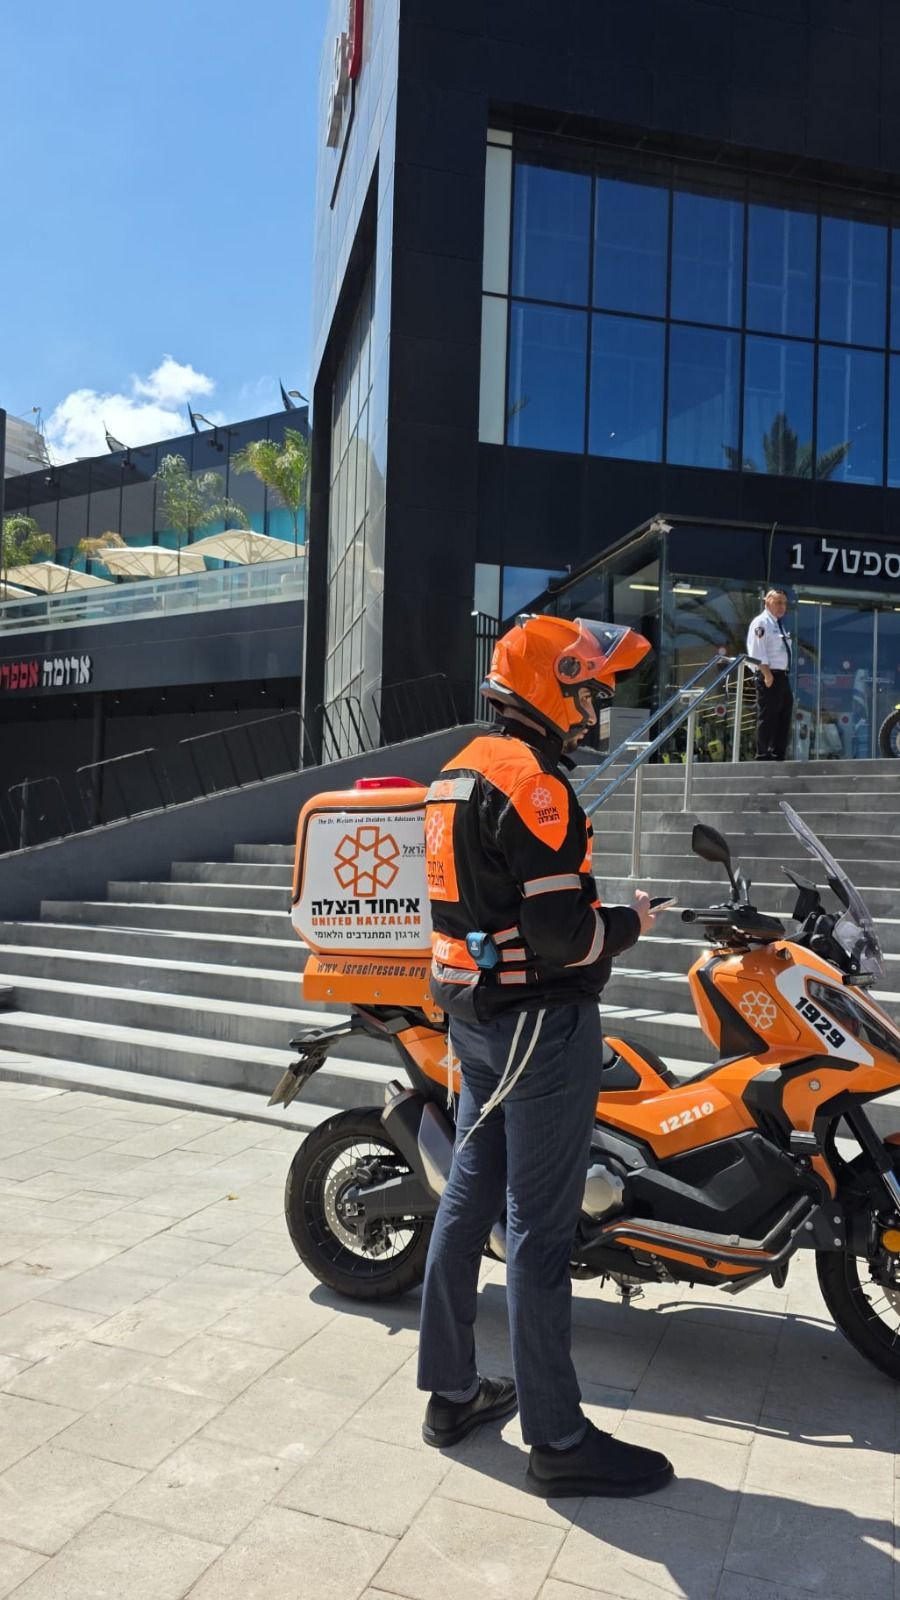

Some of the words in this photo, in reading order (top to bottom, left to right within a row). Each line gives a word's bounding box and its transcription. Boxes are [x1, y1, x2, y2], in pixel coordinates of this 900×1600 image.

[791, 543, 805, 570] 1
[0, 660, 39, 689] אספר
[42, 654, 91, 687] ארומה
[312, 899, 360, 915] הצלה
[365, 898, 420, 914] איחוד
[312, 917, 352, 926] UNITED
[357, 915, 421, 926] HATZALAH
[314, 930, 343, 939] הלאומי
[346, 931, 391, 939] המתנדבים
[395, 930, 420, 941] ארגון
[795, 996, 846, 1049] 1929
[659, 1101, 714, 1135] 12210
